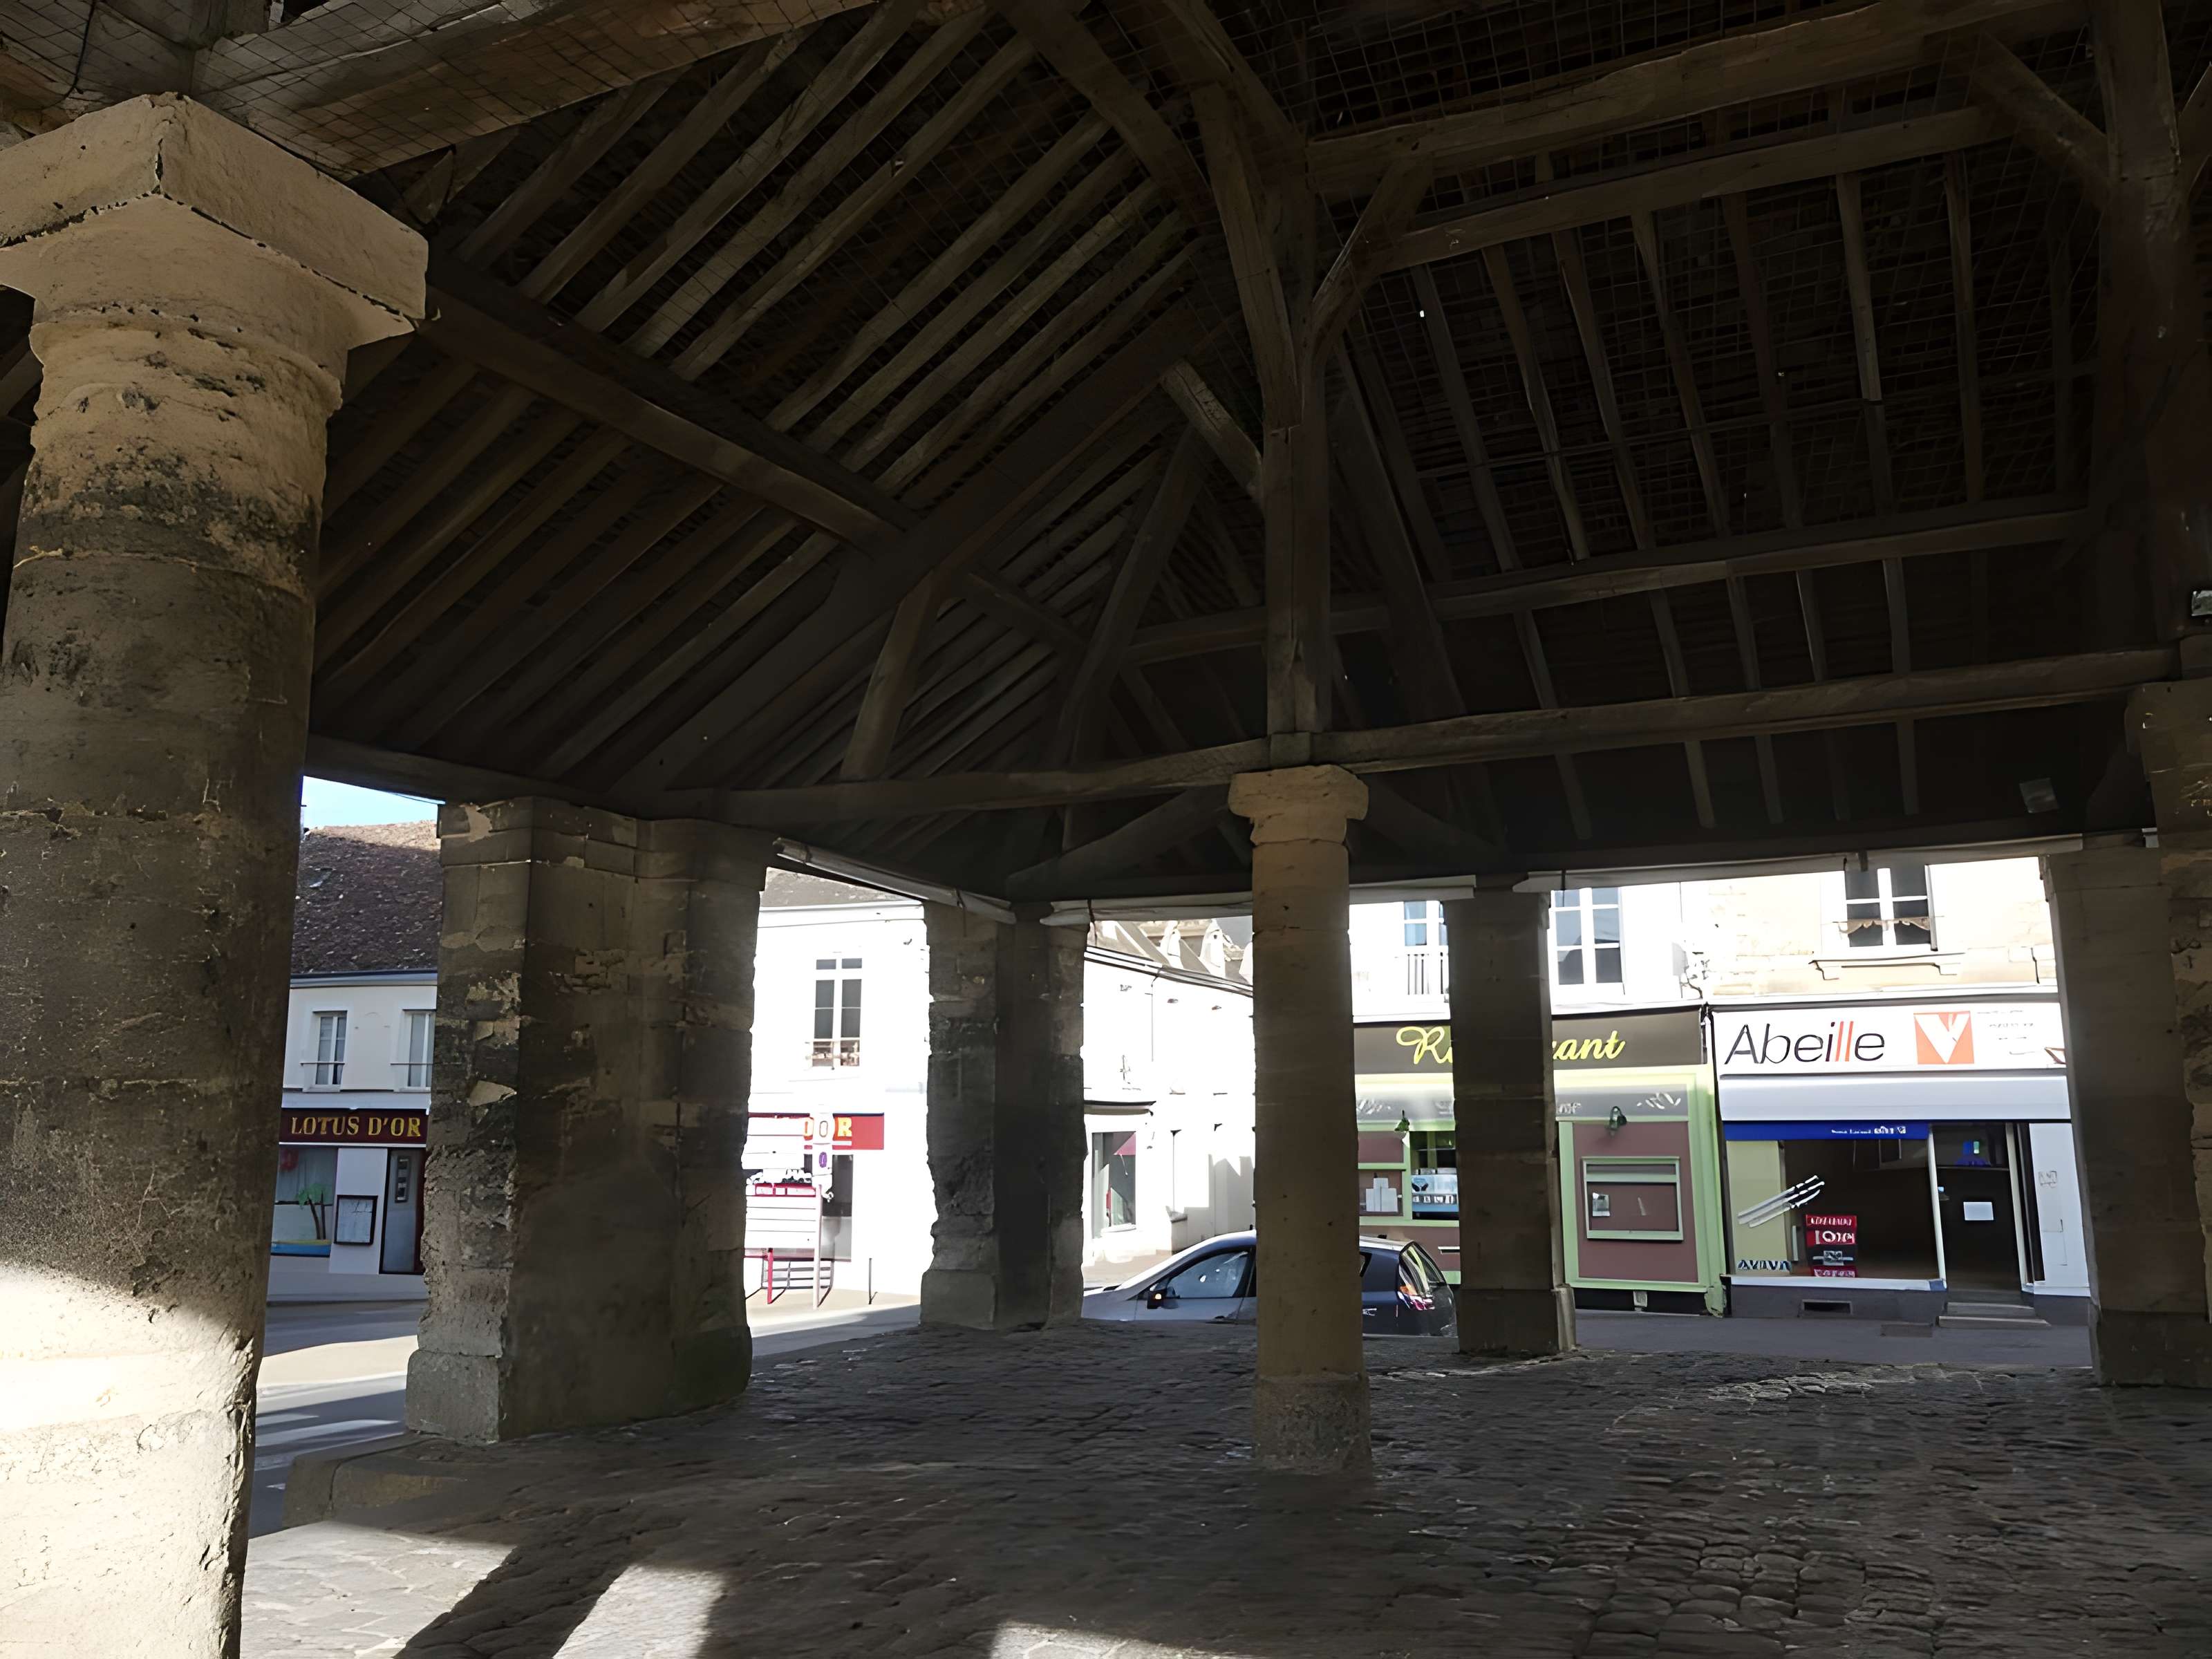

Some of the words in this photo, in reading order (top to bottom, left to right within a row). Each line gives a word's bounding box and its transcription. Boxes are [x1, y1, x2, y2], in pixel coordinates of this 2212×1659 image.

[1724, 1020, 1884, 1065] Abeille
[291, 1116, 359, 1135] LOTUS
[368, 1117, 421, 1137] D'OR
